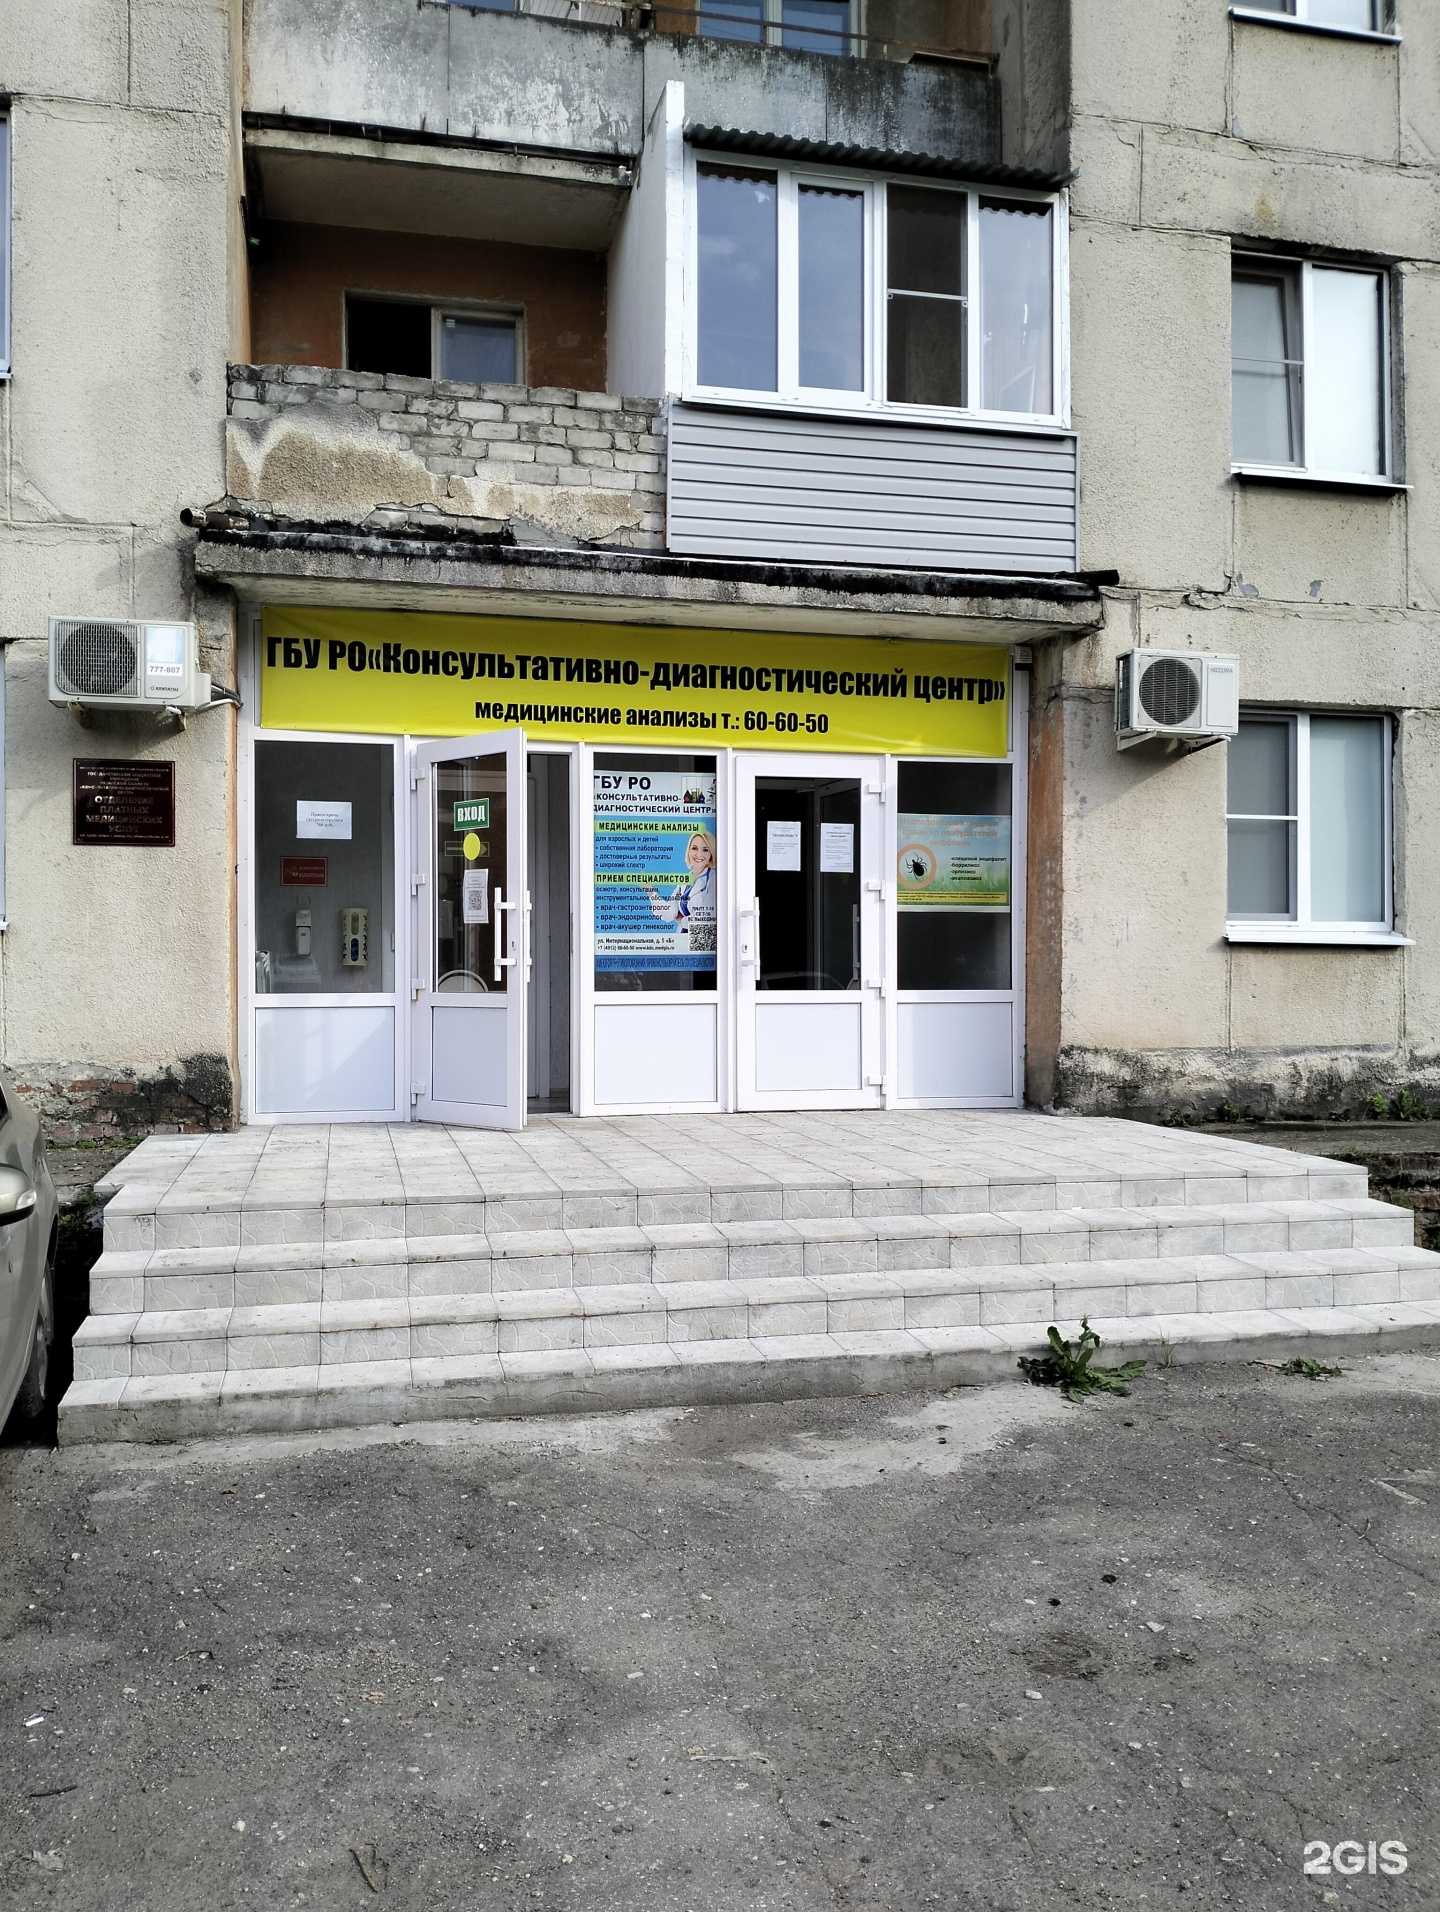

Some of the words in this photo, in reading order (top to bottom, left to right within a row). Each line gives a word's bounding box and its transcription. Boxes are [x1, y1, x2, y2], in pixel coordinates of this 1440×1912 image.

[267, 636, 321, 669] ГБУ
[912, 674, 1006, 705] центр»
[475, 701, 622, 726] медицинские
[626, 708, 716, 730] анализы
[744, 710, 830, 734] 60-60-50
[628, 776, 652, 790] РО
[594, 793, 682, 802] КОНСУЛЬТАТИВНО-
[457, 805, 485, 822] ВХОД
[598, 822, 659, 832] МЕДИЦИНСКИЕ
[661, 823, 699, 832] АНАЛИЗЫ
[596, 874, 624, 882] ПРИЕМ
[626, 875, 690, 883] СПЕЦИАЛИСТОВ
